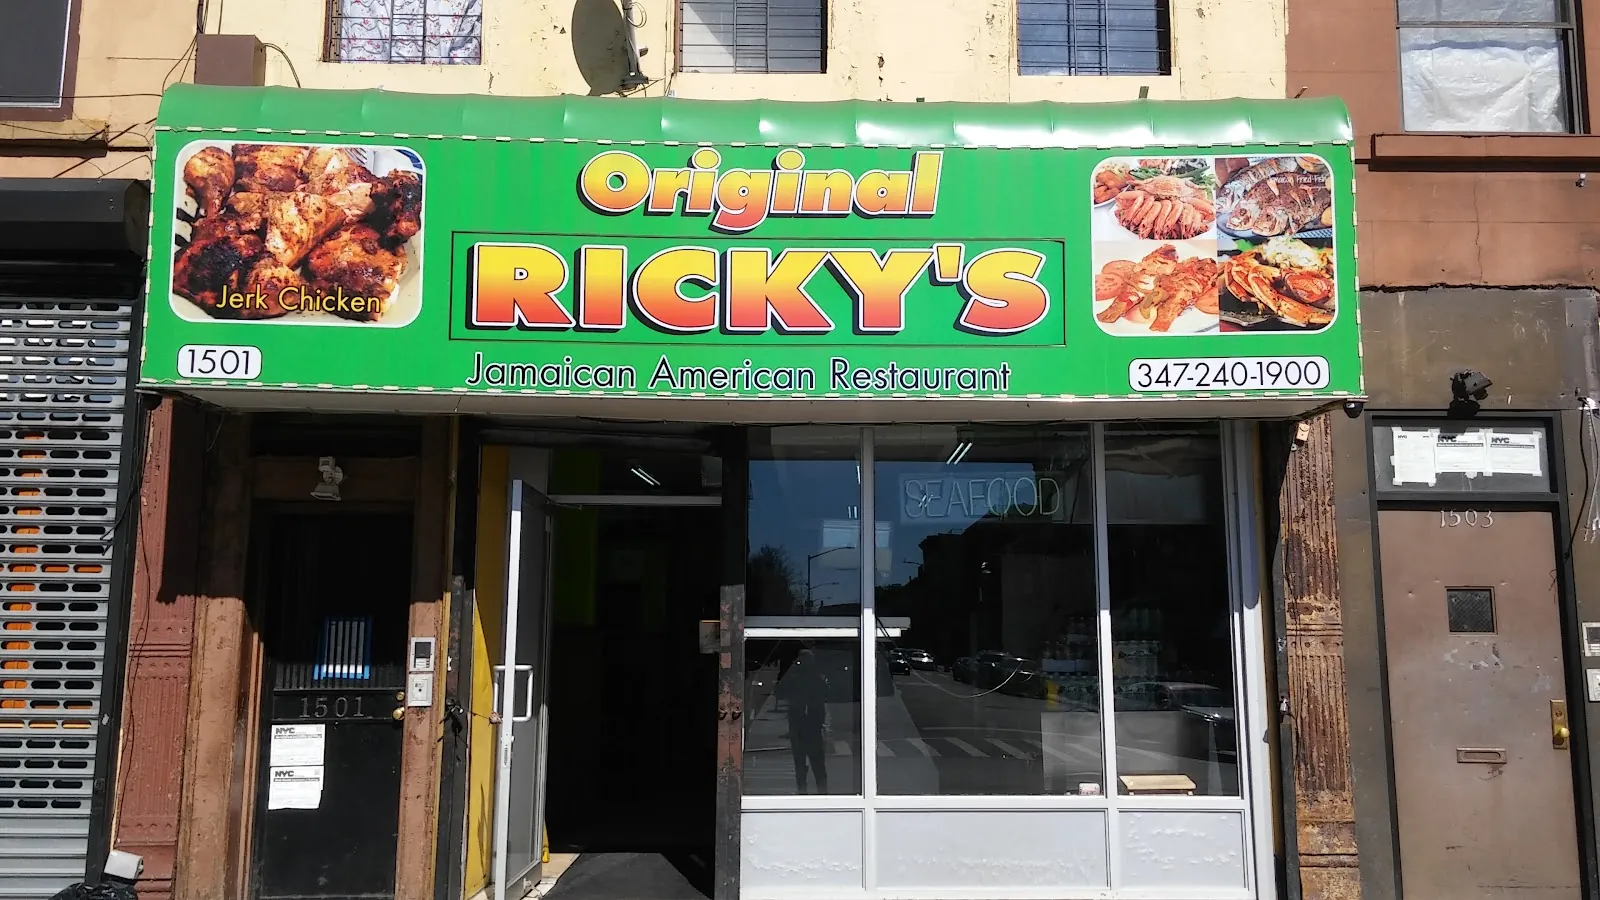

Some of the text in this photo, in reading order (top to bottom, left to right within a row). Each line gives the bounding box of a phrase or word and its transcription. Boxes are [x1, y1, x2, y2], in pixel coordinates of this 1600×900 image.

[579, 148, 944, 233] Original
[215, 284, 382, 315] Jerk Chicken
[467, 241, 1051, 336] RICKY'S
[187, 349, 251, 376] 1501
[467, 352, 1011, 393] Jamaican American Restaurant
[1137, 360, 1322, 388] 347-240-1900
[905, 477, 1060, 519] SEAFOOD
[1439, 508, 1495, 529] 1503
[299, 697, 364, 718] 1501
[275, 727, 296, 735] NYC
[274, 770, 294, 778] NYC
